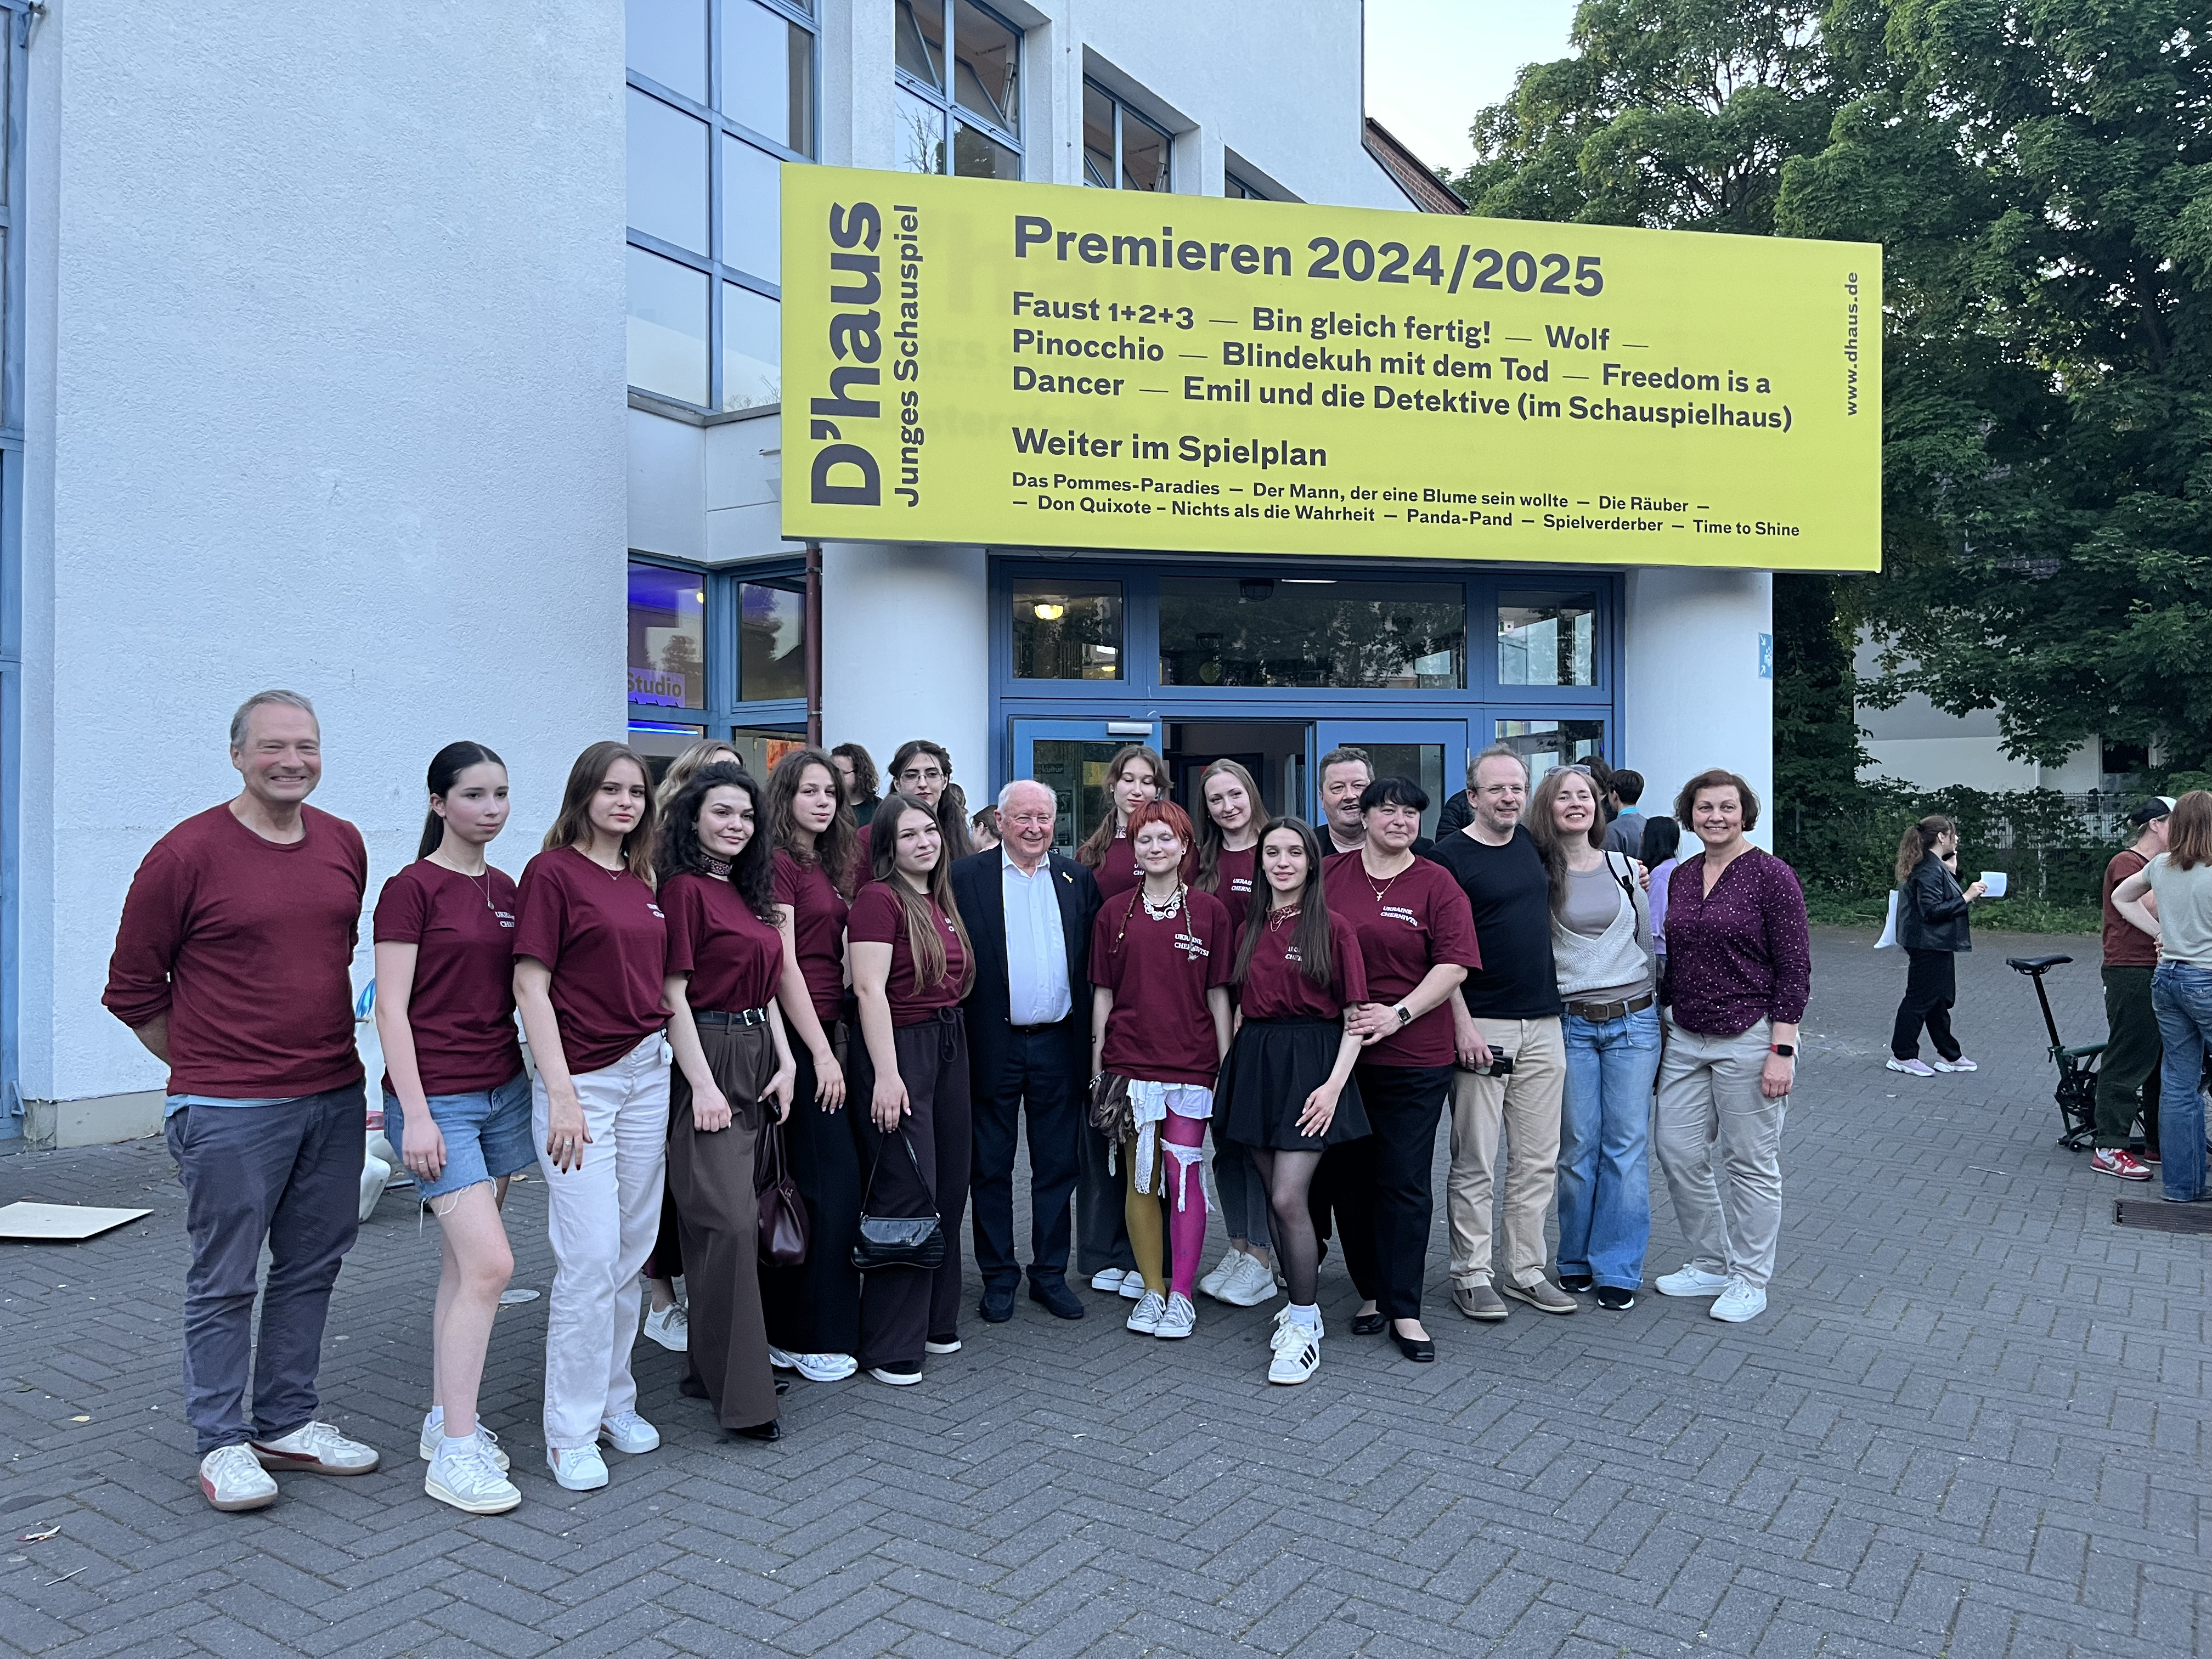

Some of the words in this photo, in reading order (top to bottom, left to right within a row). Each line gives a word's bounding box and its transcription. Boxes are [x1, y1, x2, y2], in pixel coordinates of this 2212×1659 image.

[1015, 215, 1291, 276] Premieren
[1307, 236, 1604, 297] 2024/2025
[893, 204, 924, 383] Schauspiel
[1013, 291, 1100, 321] Faust
[1108, 302, 1194, 330] 1+2+3
[1253, 307, 1302, 333] Bin
[1310, 311, 1396, 340] gleich
[1403, 315, 1490, 349] fertig!
[1544, 324, 1610, 351] Wolf
[1013, 328, 1164, 362] Pinocchio
[1223, 341, 1371, 373] Blindekuh
[1380, 351, 1425, 375] mit
[1433, 353, 1492, 379] dem
[1500, 357, 1548, 382] Tod
[1603, 363, 1719, 391] Freedom
[1728, 369, 1749, 393] is
[1756, 377, 1771, 394] a
[1843, 272, 1858, 416] www.dhaus.de
[1013, 366, 1125, 396] Dancer
[1184, 375, 1250, 403] Emil
[1260, 382, 1313, 405] und
[1322, 383, 1365, 408] die
[1374, 385, 1510, 415] Detektive
[1517, 392, 1561, 421] (im
[1568, 396, 1792, 433] Schauspielhaus)
[894, 390, 925, 508] Junges
[1011, 427, 1123, 458] Weiter
[1132, 433, 1169, 460] im
[1178, 435, 1327, 470] Spielplan
[1013, 471, 1048, 488] Das
[1054, 473, 1220, 495] Pommes-Paradies
[1254, 482, 1285, 497] Der
[1290, 483, 1345, 503] Mann,
[1350, 486, 1378, 500] der
[1383, 487, 1418, 502] eine
[1423, 488, 1477, 504] Blume
[1481, 491, 1515, 506] sein
[1519, 493, 1568, 508] wollte
[1599, 495, 1626, 510] Die
[1630, 496, 1689, 512] Räuber
[1038, 495, 1075, 511] Don
[1080, 496, 1152, 514] Quixote
[1172, 500, 1230, 517] Nichts
[1234, 503, 1260, 518] als
[1264, 504, 1290, 519] die
[1294, 505, 1375, 521] Wahrheit
[1407, 509, 1512, 526] Panda-Pand
[1543, 514, 1663, 531] Spielverderber
[1692, 519, 1732, 534] Time
[1735, 522, 1751, 534] to
[1755, 521, 1799, 537] Shine
[1383, 906, 1413, 915] UKRAINE
